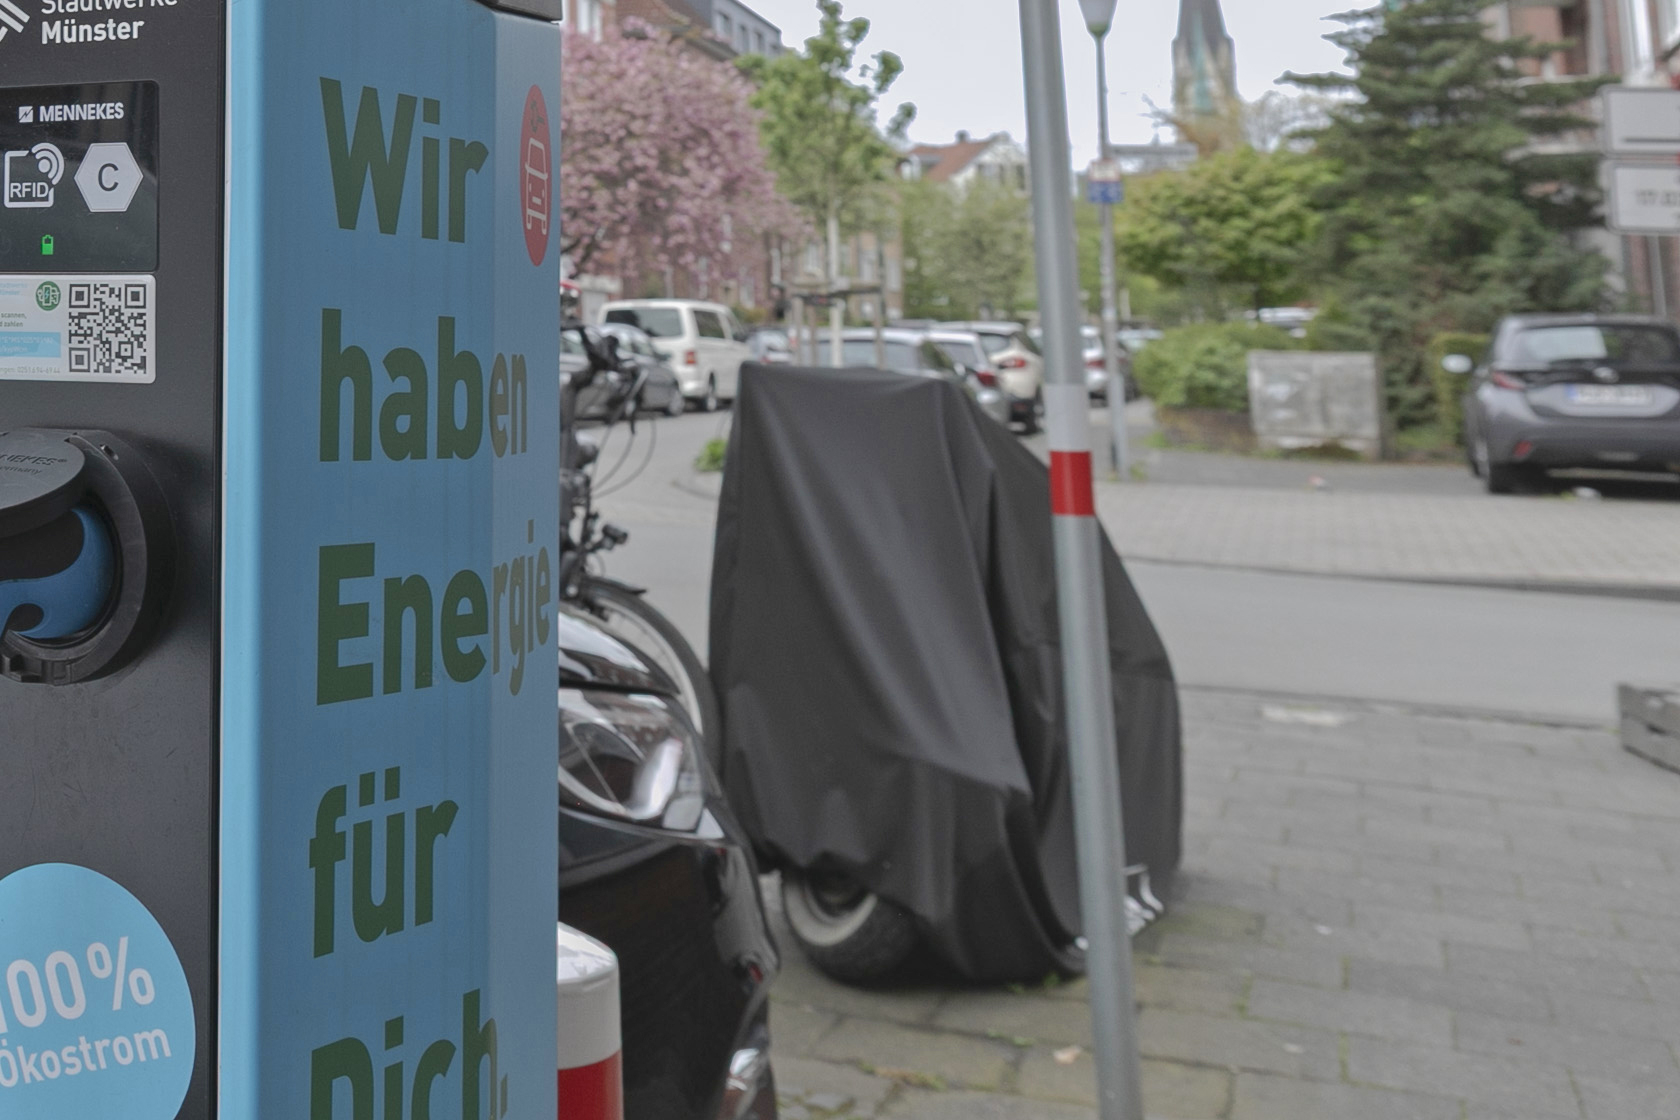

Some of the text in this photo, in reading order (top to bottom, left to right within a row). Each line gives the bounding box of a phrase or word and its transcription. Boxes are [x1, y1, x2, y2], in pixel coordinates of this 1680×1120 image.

[41, 18, 145, 45] Münster
[39, 102, 124, 123] MENNEKES
[319, 76, 489, 244] Wir
[10, 182, 49, 198] RFID
[98, 162, 119, 192] C
[1, 312, 27, 320] scannen,
[319, 307, 527, 462] haben
[317, 520, 551, 706] Energie
[309, 765, 459, 959] für
